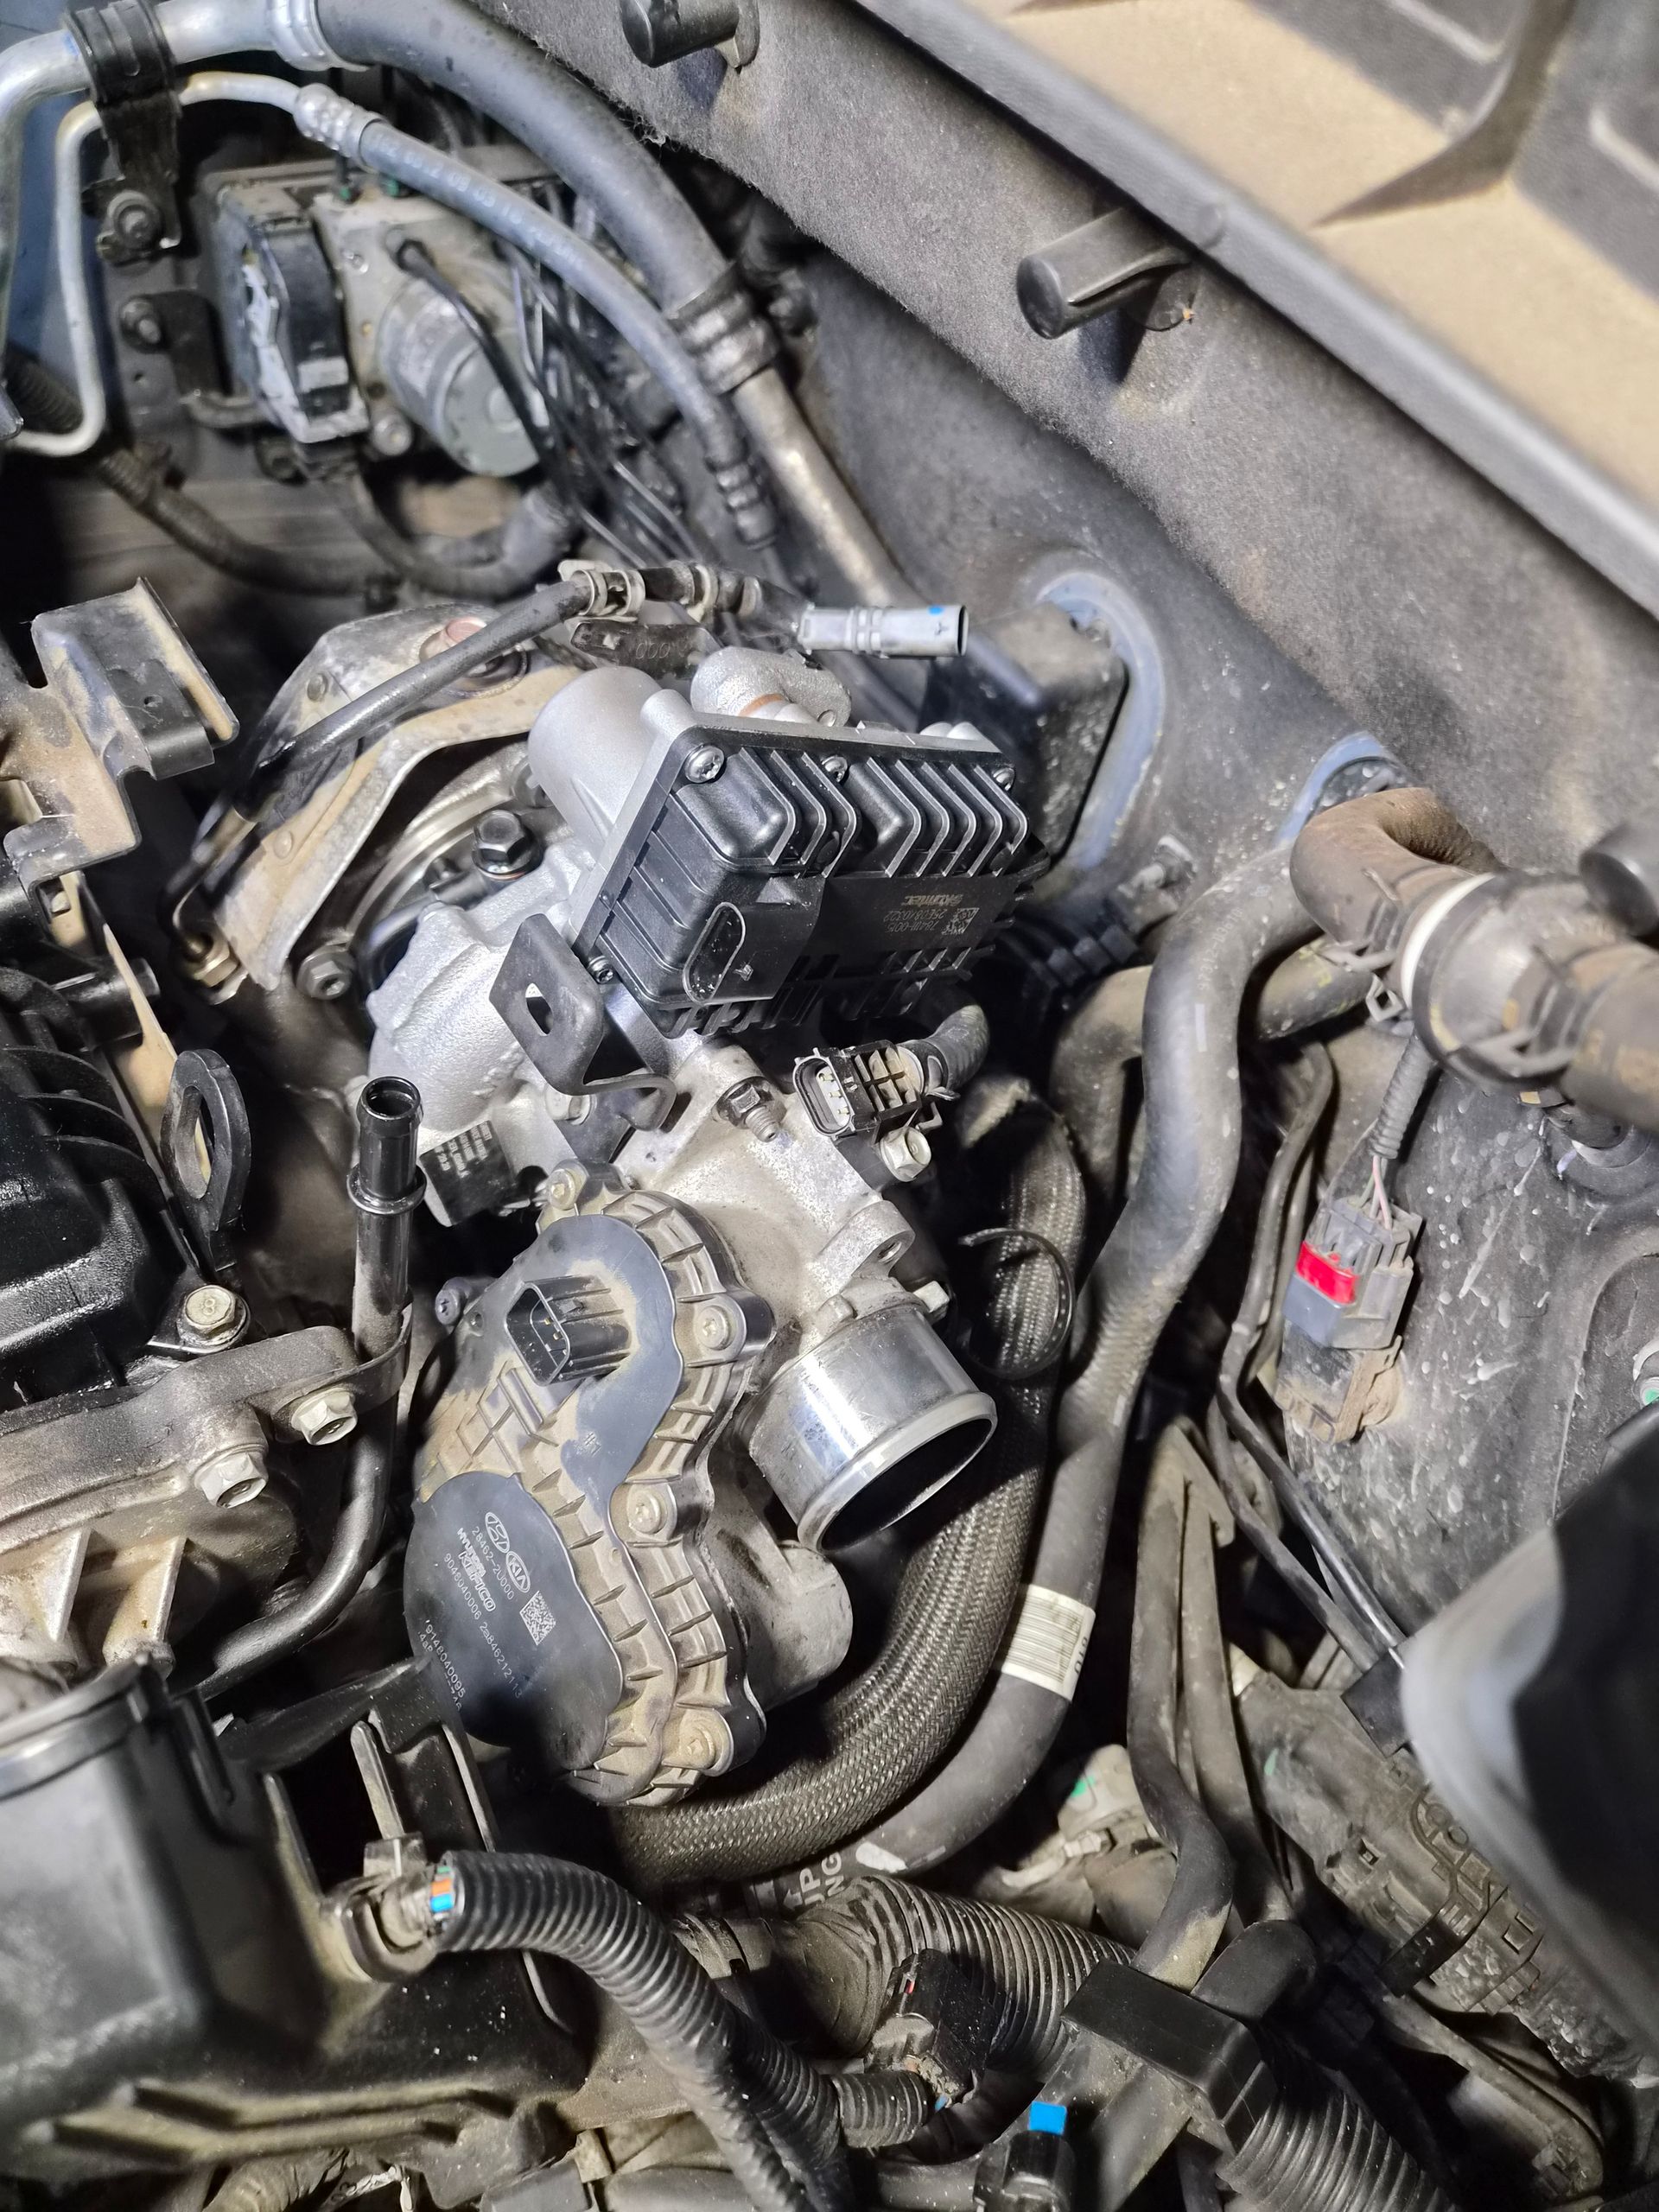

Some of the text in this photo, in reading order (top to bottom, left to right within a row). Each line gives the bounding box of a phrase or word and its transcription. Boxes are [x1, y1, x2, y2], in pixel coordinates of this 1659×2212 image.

[456, 1527, 487, 1579] HYUNDAI
[459, 1551, 497, 1612] KEFICO
[471, 1526, 515, 1600] 28462-2U000
[507, 1556, 529, 1590] KIA
[443, 1553, 482, 1620] 9048040006
